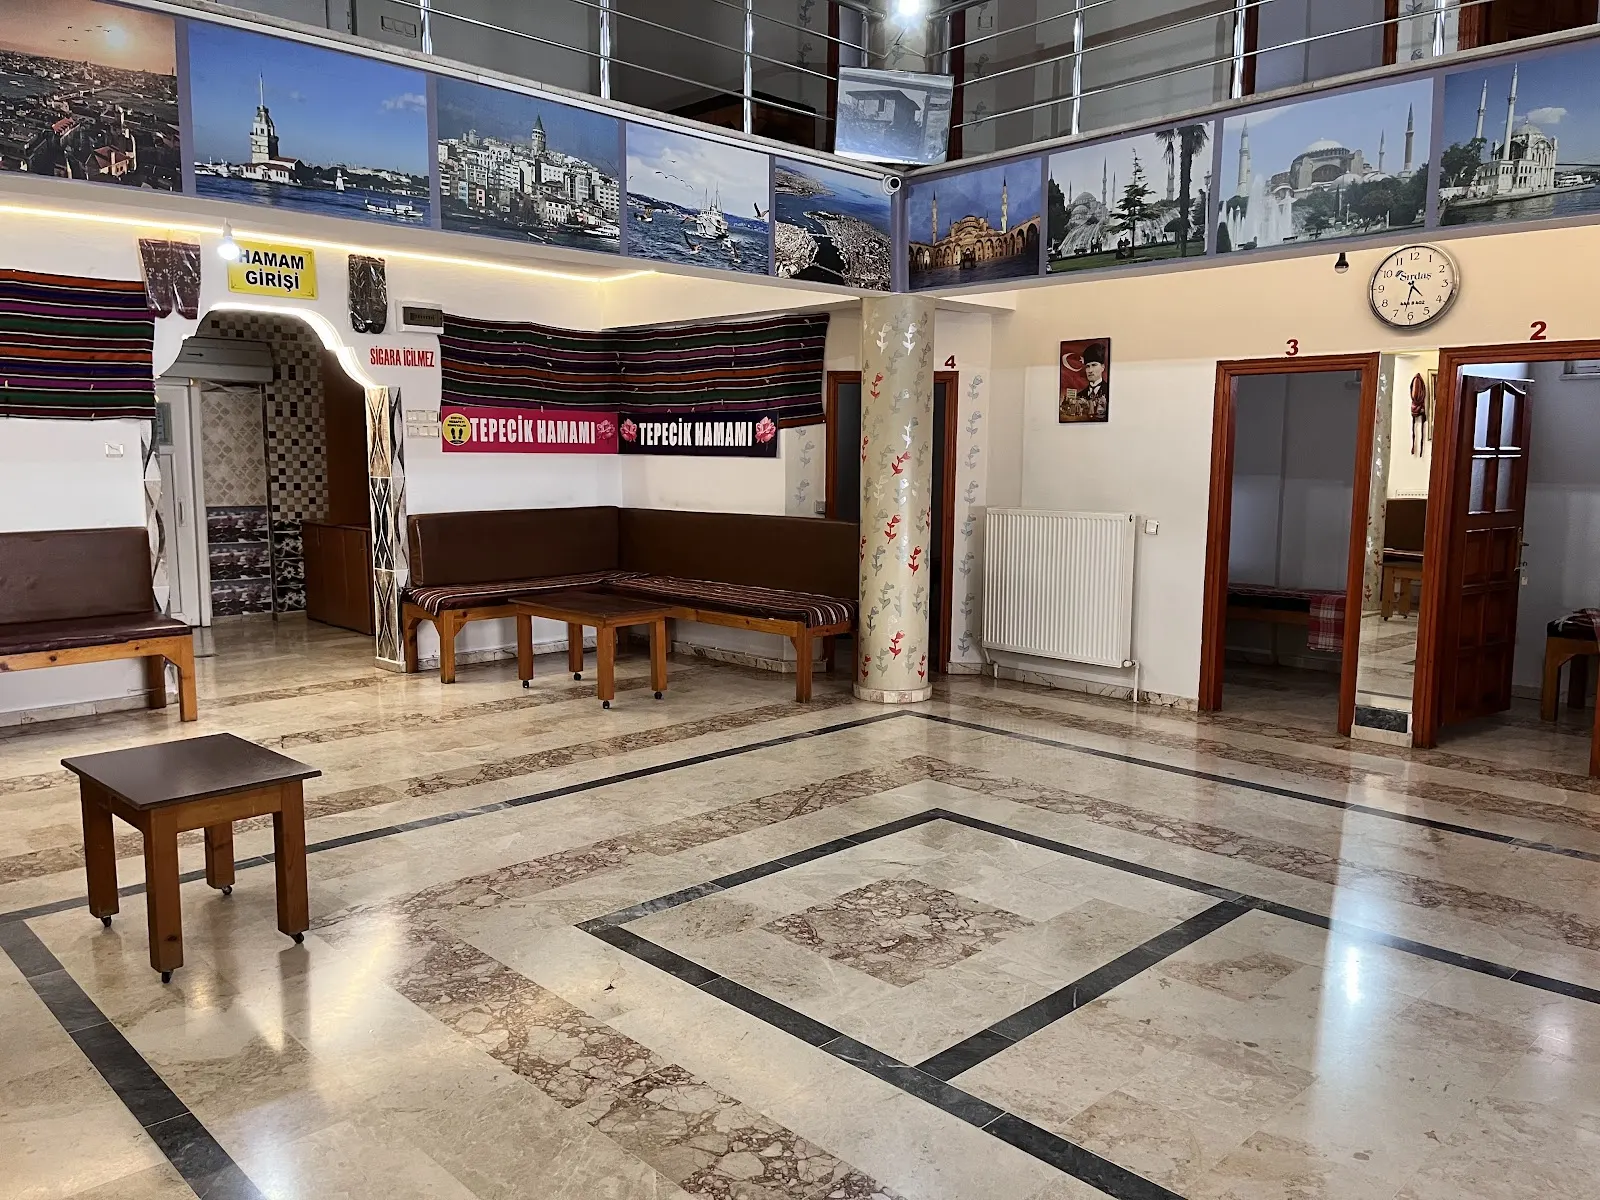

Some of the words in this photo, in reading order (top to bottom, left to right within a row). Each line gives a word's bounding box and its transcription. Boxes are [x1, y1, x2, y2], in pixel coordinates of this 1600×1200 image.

[239, 248, 304, 270] HAMAM
[1410, 252, 1420, 261] 12
[1396, 258, 1403, 266] 11
[1438, 265, 1445, 273] 2
[1383, 270, 1393, 278] 10
[245, 268, 299, 292] GİRİŞİ
[1441, 279, 1449, 288] 3
[1378, 285, 1385, 293] 9
[1381, 299, 1388, 307] 8
[1436, 295, 1442, 303] 4
[1423, 307, 1430, 315] 5
[1407, 312, 1414, 320] 6
[1530, 321, 1547, 340] 2
[1285, 339, 1299, 356] 3
[370, 345, 401, 366] SİGARA
[944, 354, 956, 369] 4
[470, 415, 534, 443] TEPECİK
[537, 419, 596, 444] HAMAMI
[639, 417, 692, 446] TEPECİK
[695, 421, 753, 447] HAMAMI
